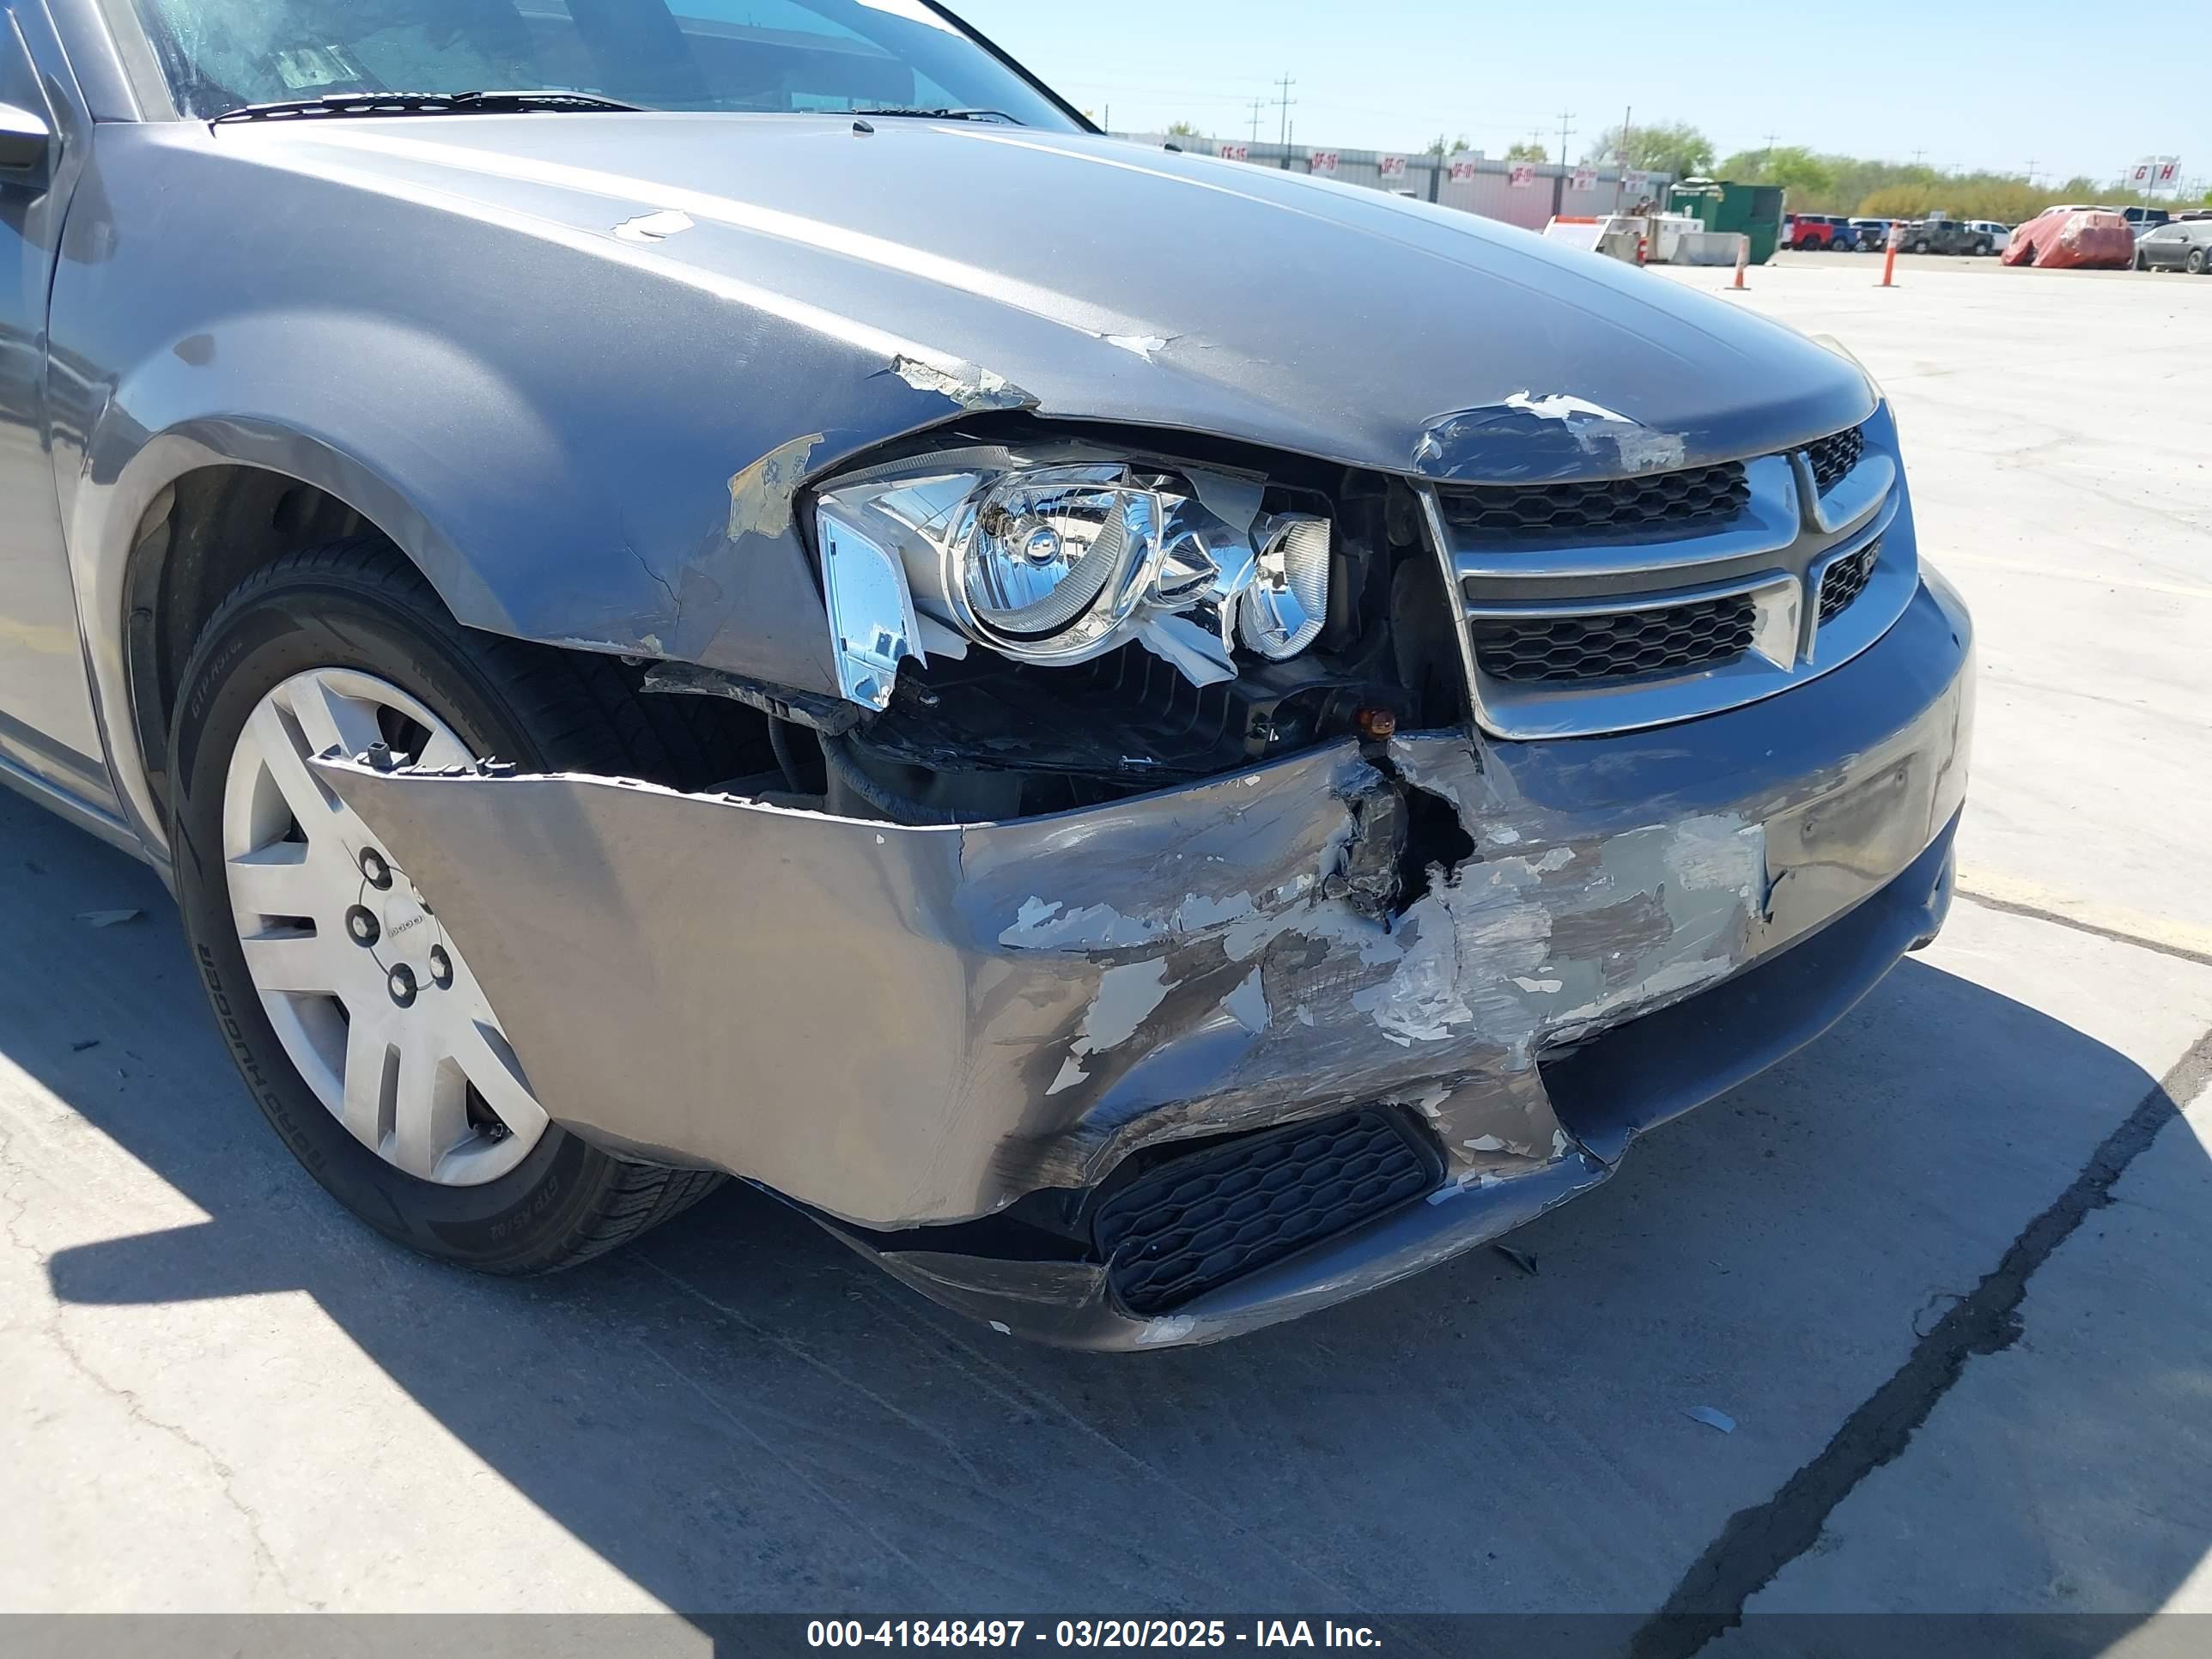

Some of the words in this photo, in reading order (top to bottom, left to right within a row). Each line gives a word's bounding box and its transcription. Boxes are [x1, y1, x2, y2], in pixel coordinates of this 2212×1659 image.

[2135, 165, 2148, 180] G
[2160, 164, 2175, 180] H
[389, 915, 424, 938] DODGE
[197, 942, 268, 1088] HUGGER
[263, 1091, 329, 1174] ROAD
